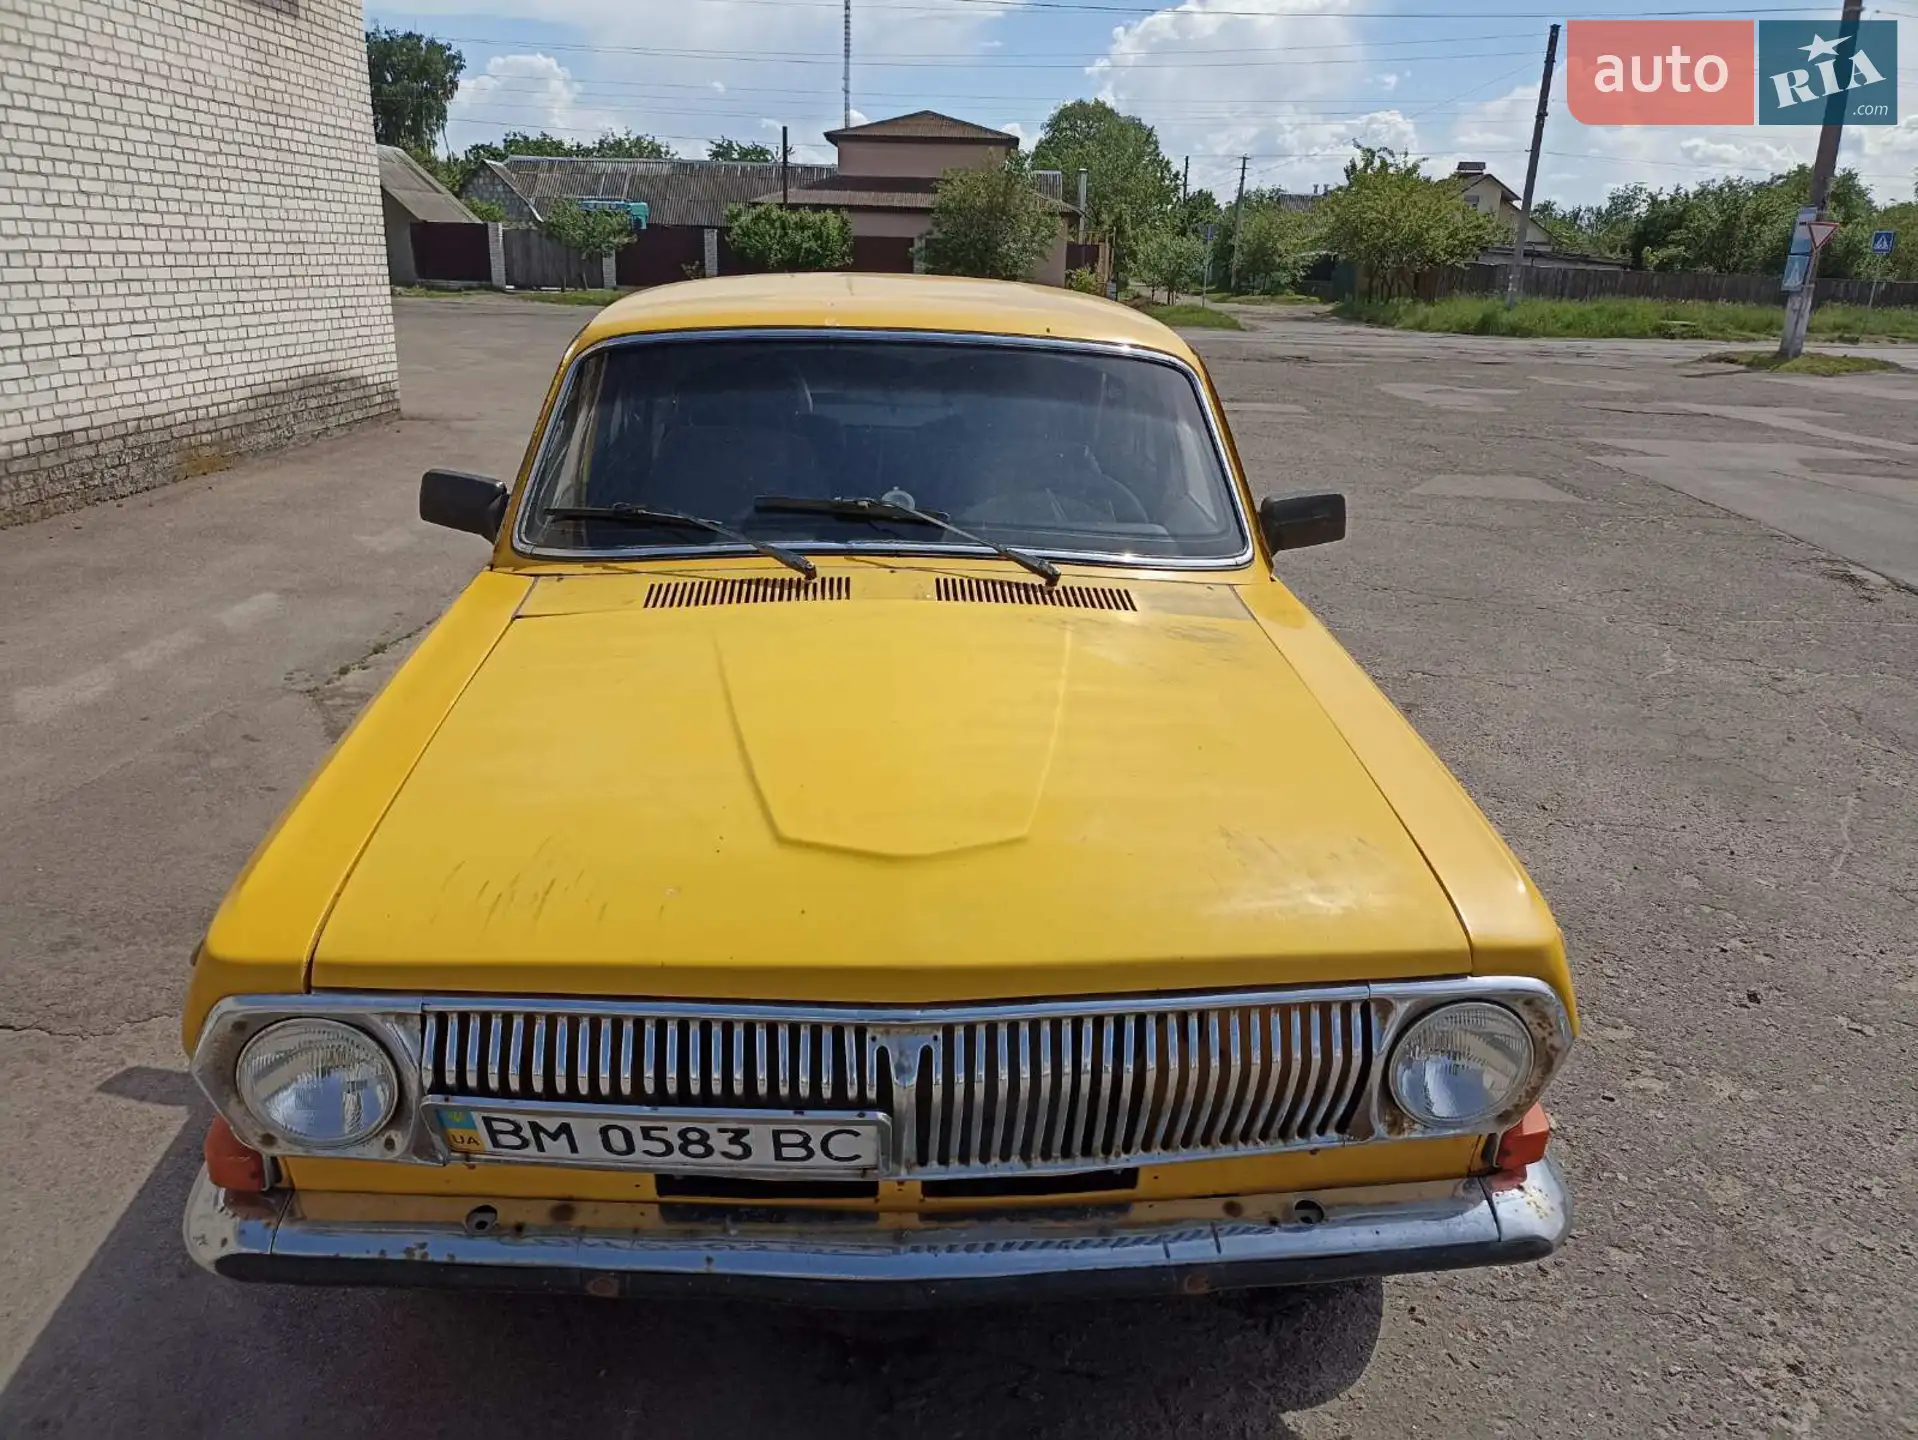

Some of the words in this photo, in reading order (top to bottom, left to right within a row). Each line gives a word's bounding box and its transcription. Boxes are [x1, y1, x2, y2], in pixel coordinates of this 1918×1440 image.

[452, 1134, 481, 1147] UA
[481, 1115, 580, 1154] BM
[600, 1124, 753, 1160] 0583
[772, 1128, 863, 1162] BC
